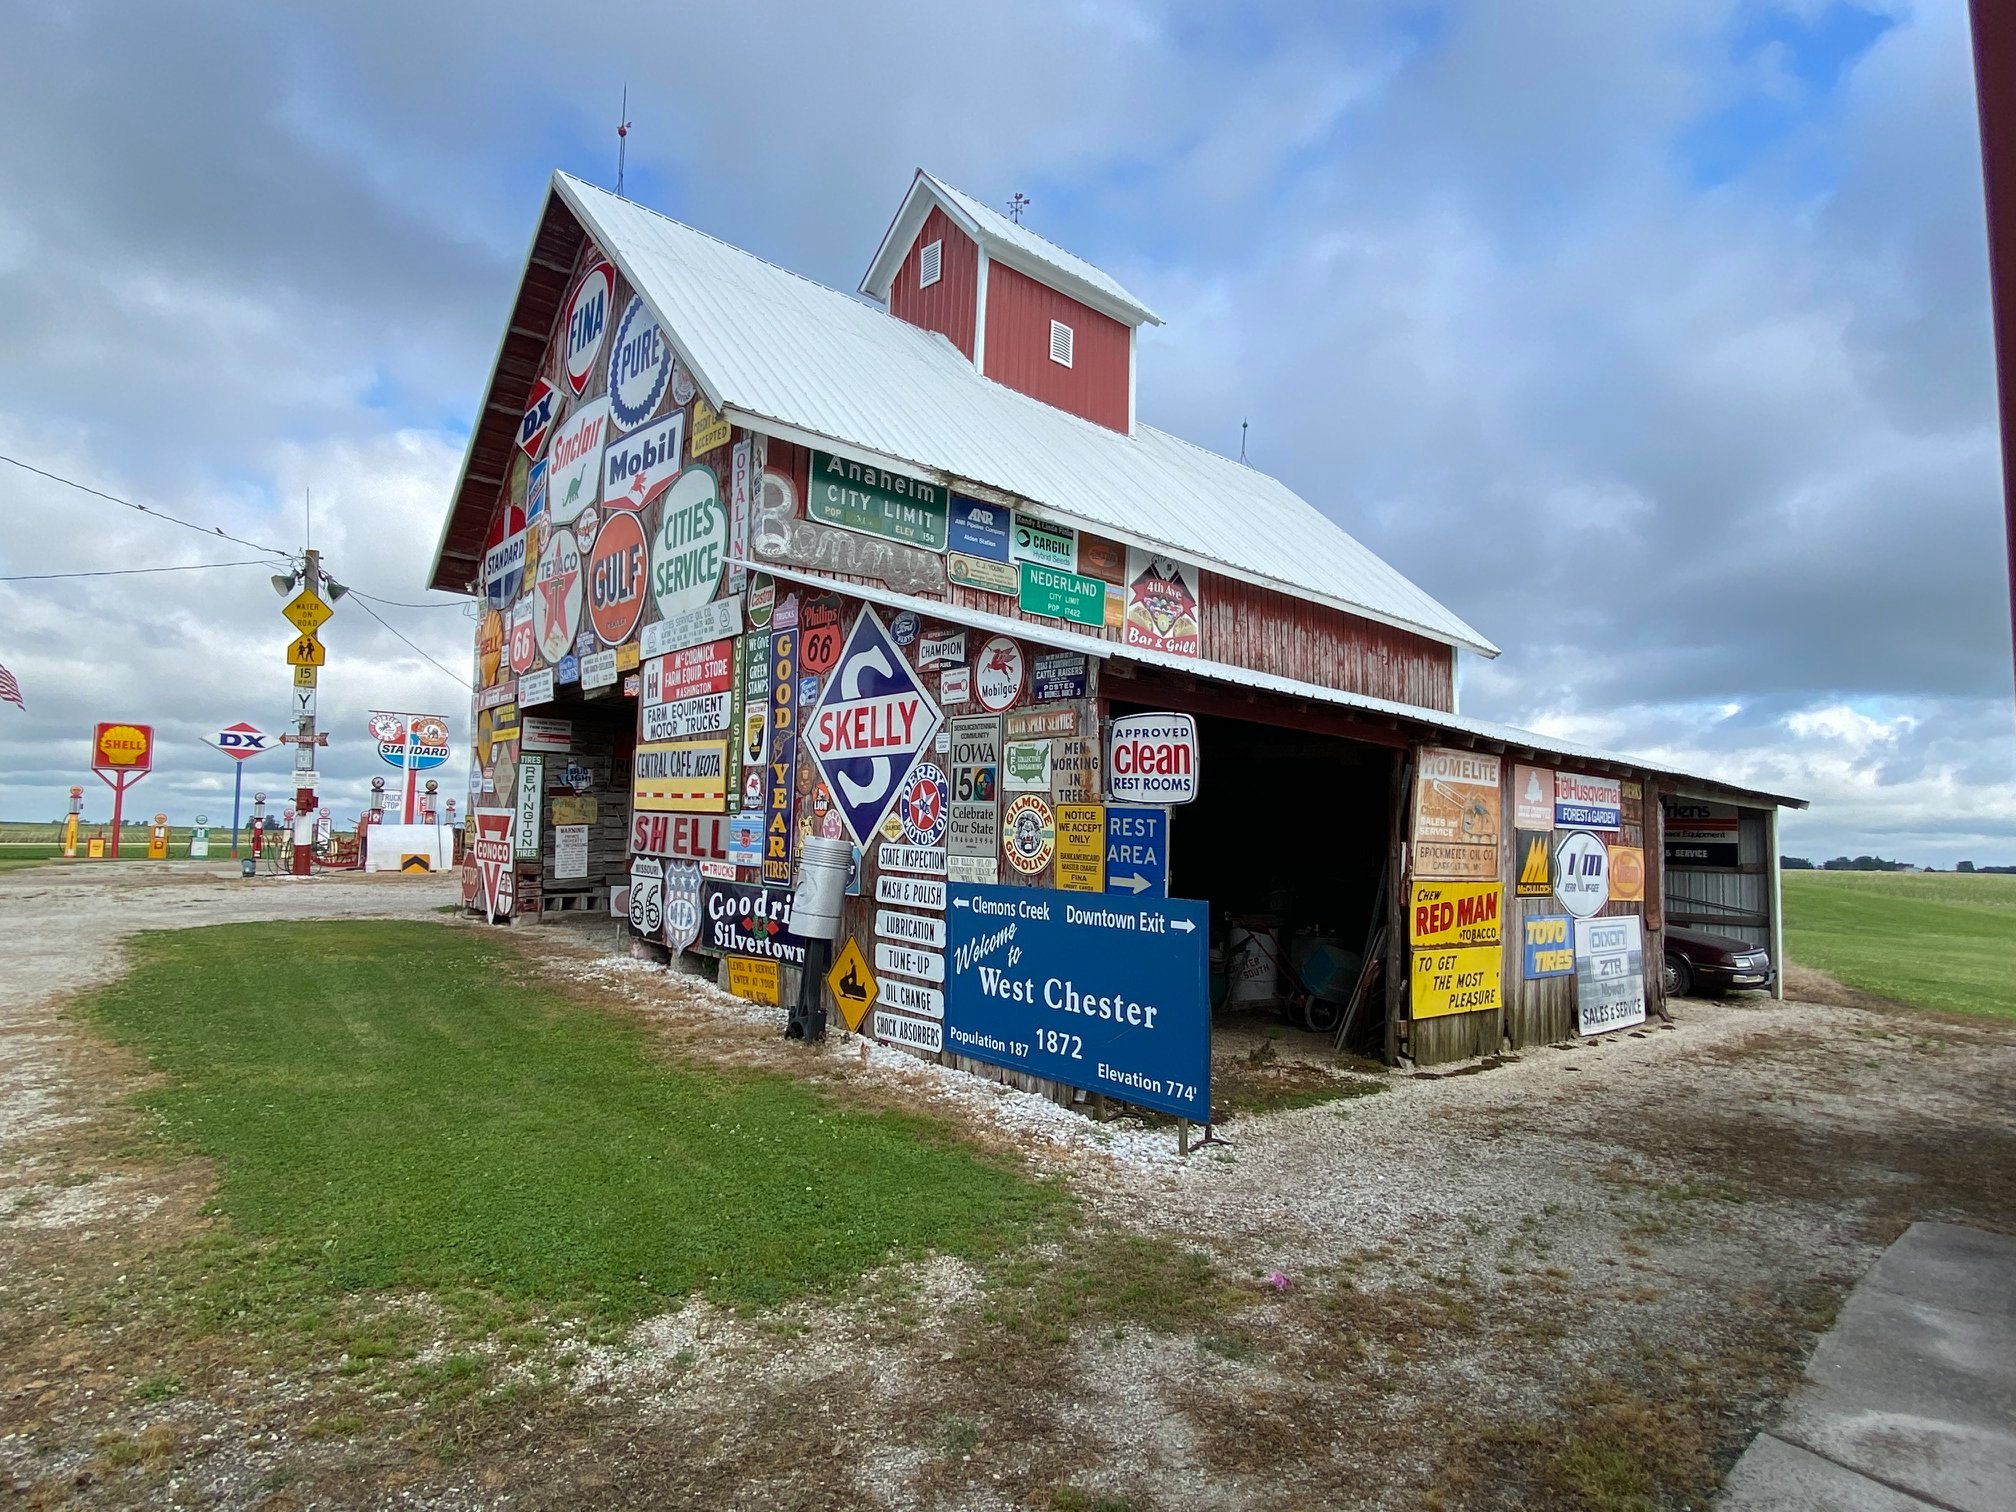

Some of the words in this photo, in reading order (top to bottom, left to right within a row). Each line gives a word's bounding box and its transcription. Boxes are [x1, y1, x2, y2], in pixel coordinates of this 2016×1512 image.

[568, 288, 604, 360] FINA
[620, 323, 661, 386] PURE
[522, 392, 554, 443] DX
[551, 415, 604, 476] Sinclair
[694, 426, 727, 451] ACCEPTED
[609, 427, 676, 486] Mobil
[826, 455, 935, 504] Anaheim
[733, 452, 746, 575] OPALINE
[827, 484, 872, 511] CITY
[883, 499, 934, 529] LIMIT
[967, 508, 994, 526] ANR
[664, 497, 714, 551] CITIES
[824, 506, 842, 517] POP
[895, 525, 915, 537] ELEV
[922, 533, 935, 543] 158
[487, 538, 524, 576] STANDARD
[1033, 534, 1071, 557] CARGILL
[540, 551, 578, 579] TEXACO
[592, 543, 643, 612] GULF
[656, 541, 718, 598] SERVICE
[1030, 569, 1097, 597] NEDERLAND
[1146, 581, 1164, 594] 4th
[1165, 585, 1182, 600] Ave
[296, 603, 319, 611] WATER
[1047, 603, 1060, 612] POP
[1064, 606, 1081, 618] 17422
[1048, 592, 1062, 602] CITY
[1064, 596, 1080, 606] LIMIT
[302, 611, 313, 619] ON
[804, 603, 837, 627] Phillips
[513, 631, 531, 662] 66
[748, 638, 758, 652] WE
[757, 636, 770, 648] GIVE
[807, 633, 833, 663] 66
[921, 641, 962, 659] CHAMPION
[1128, 626, 1153, 646] Bar
[1154, 639, 1163, 648] &
[1165, 638, 1196, 654] Grill
[674, 644, 715, 669] McCORMICK
[300, 668, 311, 679] 15
[664, 668, 682, 688] FARM
[704, 658, 728, 679] STORE
[734, 636, 743, 714] QUAKER
[749, 663, 768, 680] GREEN
[774, 635, 793, 729] GOOD
[1036, 669, 1056, 680] CATTLE
[1057, 665, 1083, 677] RAISERS
[675, 682, 712, 699] WASHINGTON
[748, 679, 769, 696] STAMPS
[981, 682, 1018, 699] Mobilgas
[1043, 682, 1075, 692] POSTED
[298, 694, 311, 709] Y
[647, 706, 668, 724] FARM
[671, 695, 724, 720] EQUIPMENT
[649, 721, 678, 739] MOTOR
[685, 713, 720, 733] TRUCKS
[819, 699, 919, 753] SKELLY
[1115, 727, 1189, 738] APPROVED
[104, 739, 142, 751] SHELL
[218, 733, 267, 749] DX
[952, 743, 996, 763] IOWA
[1064, 742, 1086, 754] MEN
[520, 755, 541, 765] TIRES
[636, 752, 668, 778] CENTRAL
[694, 755, 720, 777] KEOTA
[730, 724, 740, 788] STATE
[1051, 757, 1099, 771] WORKING
[1114, 740, 1190, 775] clean
[1424, 755, 1497, 782] HOMELITE
[566, 774, 592, 783] LIGHT
[570, 767, 589, 776] BUD
[902, 765, 944, 801] DERBY
[1069, 774, 1080, 786] IN
[1114, 778, 1140, 790] REST
[1143, 777, 1191, 791] ROOMS
[951, 767, 996, 802] 150
[1058, 789, 1091, 803] TREES
[1569, 779, 1617, 806] Husqvarna
[522, 766, 537, 848] REMINGTON
[768, 763, 790, 858] YEAR
[813, 800, 828, 810] LION
[952, 806, 994, 820] Celebrate
[1006, 796, 1052, 827] GILMORE
[1064, 811, 1097, 821] NOTICE
[1562, 807, 1589, 821] FOREST
[1591, 810, 1616, 825] GARDEN
[633, 815, 726, 860] SHELL
[904, 817, 936, 844] MOTOR
[950, 820, 968, 834] Our
[970, 820, 994, 835] State
[1059, 823, 1071, 832] WE
[1071, 823, 1102, 832] ACCEPT
[1068, 834, 1091, 844] ONLY
[1110, 817, 1157, 838] REST
[477, 840, 510, 859] CONOCO
[516, 849, 537, 857] TIRES
[880, 847, 901, 866] STATE
[901, 849, 945, 870] INSPECTION
[1005, 840, 1051, 871] GASOLINE
[1107, 844, 1158, 866] AREA
[462, 866, 478, 886] STOP
[635, 863, 659, 876] MISSOURI
[709, 863, 735, 879] TRUCKS
[764, 859, 790, 880] TIRES
[1070, 874, 1087, 882] FINA
[881, 879, 901, 900] WASH
[903, 882, 910, 900] &
[913, 885, 943, 906] POLISH
[1416, 887, 1442, 902] CHEW
[630, 882, 660, 929] 66
[972, 895, 1017, 917] Clemons
[1018, 900, 1050, 921] Creek
[1416, 900, 1455, 937] RED
[1456, 891, 1498, 927] MAN
[886, 915, 935, 942] LUBRICATION
[1066, 904, 1136, 931] Downtown
[1139, 911, 1166, 934] Exit
[713, 920, 806, 963] Silvertown
[1461, 927, 1497, 940] TOBACCO
[1526, 919, 1566, 945] TOYO
[953, 922, 1018, 976] Welcome
[1007, 945, 1023, 968] to
[1534, 948, 1574, 973] TIRES
[888, 950, 930, 975] TUNE-UP
[1243, 963, 1270, 980] SOUTH
[1418, 956, 1433, 972] TO
[1437, 955, 1458, 971] GET
[1600, 958, 1623, 976] ZTR
[1432, 975, 1454, 991] THE
[1456, 971, 1485, 988] MOST
[885, 983, 898, 1002] OIL
[900, 986, 932, 1012] CHANGE
[978, 966, 1035, 1004] West
[1043, 977, 1158, 1030] Chester
[1448, 988, 1496, 1010] PLEASURE
[1582, 1005, 1609, 1025] SALES
[1610, 1007, 1615, 1020] &
[1615, 998, 1642, 1018] SERVICE
[876, 1014, 898, 1038] SHOCK
[899, 1020, 940, 1048] ABSORBERS
[950, 1026, 1006, 1053] Population
[1009, 1040, 1030, 1058] 187
[1036, 1028, 1084, 1060] 1872
[1097, 1062, 1162, 1094] Elevation
[1166, 1079, 1198, 1102] 774'
